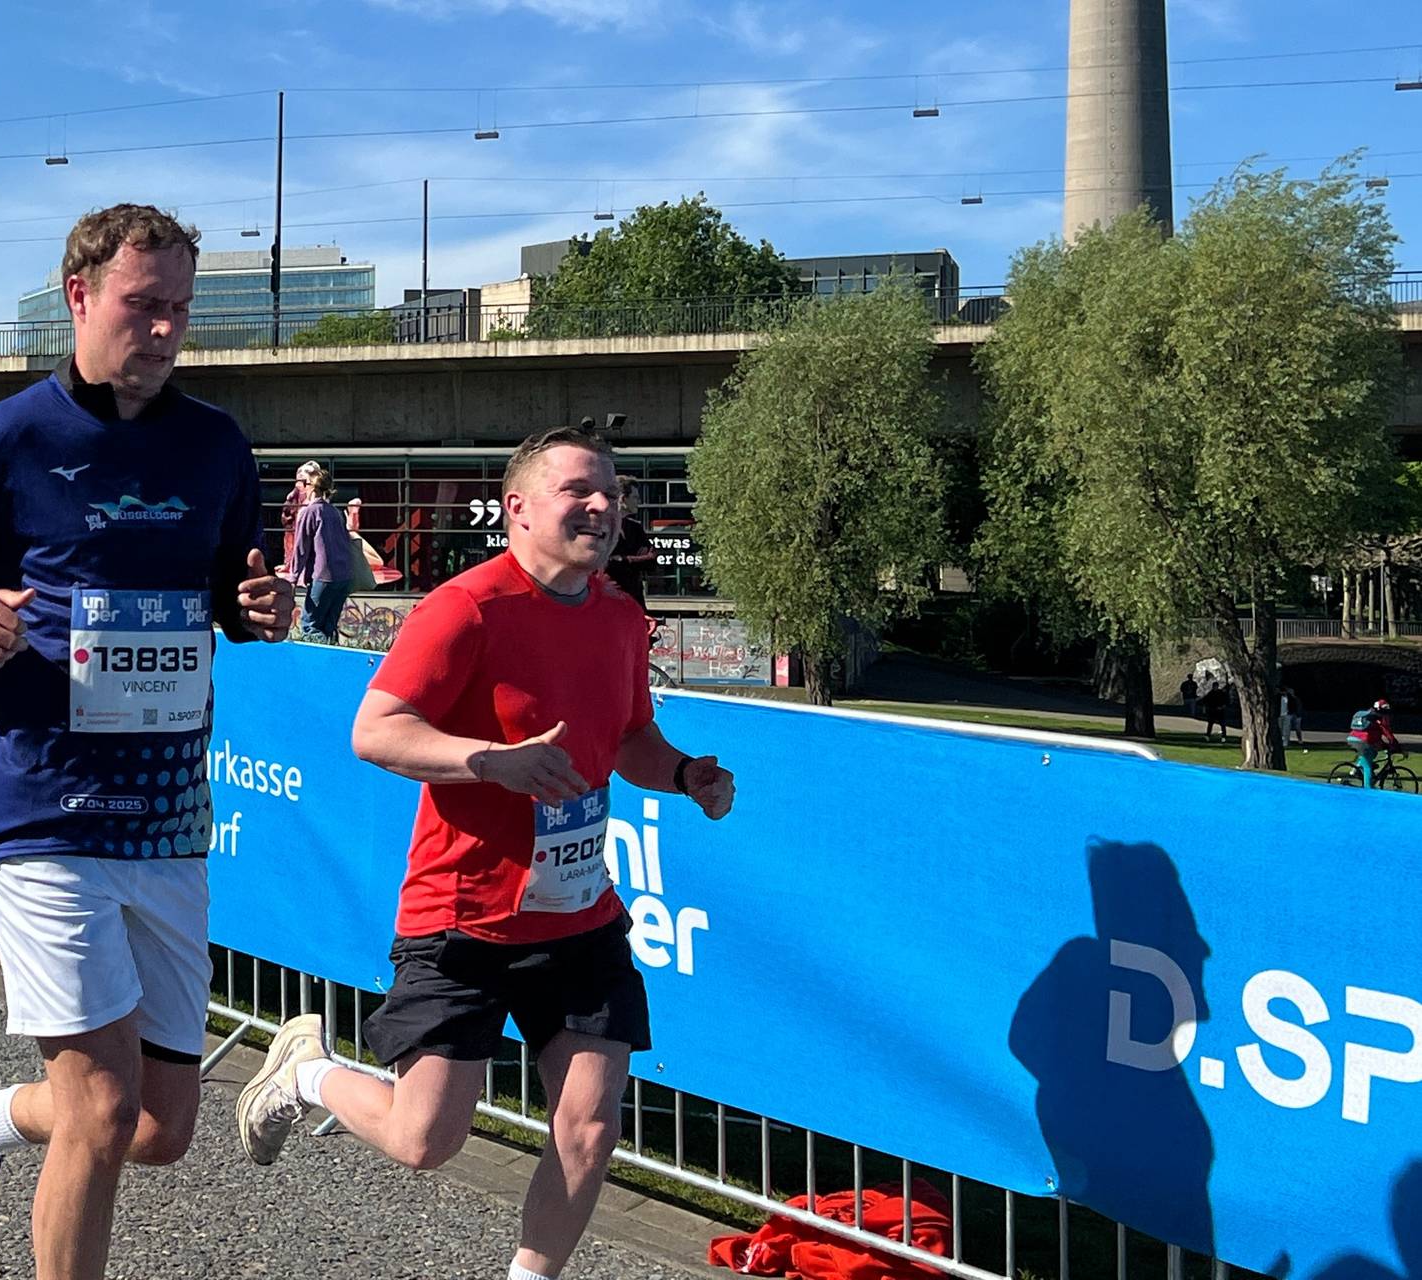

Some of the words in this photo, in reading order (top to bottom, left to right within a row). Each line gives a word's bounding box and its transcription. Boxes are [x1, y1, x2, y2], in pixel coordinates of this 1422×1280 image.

[82, 592, 110, 609] uni
[138, 594, 163, 610] uni
[182, 593, 202, 610] uni
[87, 609, 120, 625] per
[142, 610, 171, 626] per
[186, 610, 208, 626] per
[93, 646, 198, 672] 13835
[122, 680, 177, 693] VINCENT
[67, 799, 142, 810] 27.04.2025
[584, 803, 604, 822] per
[546, 811, 571, 830] per
[603, 797, 664, 896] ni
[628, 895, 710, 976] er
[1106, 938, 1422, 1124] D.SP
